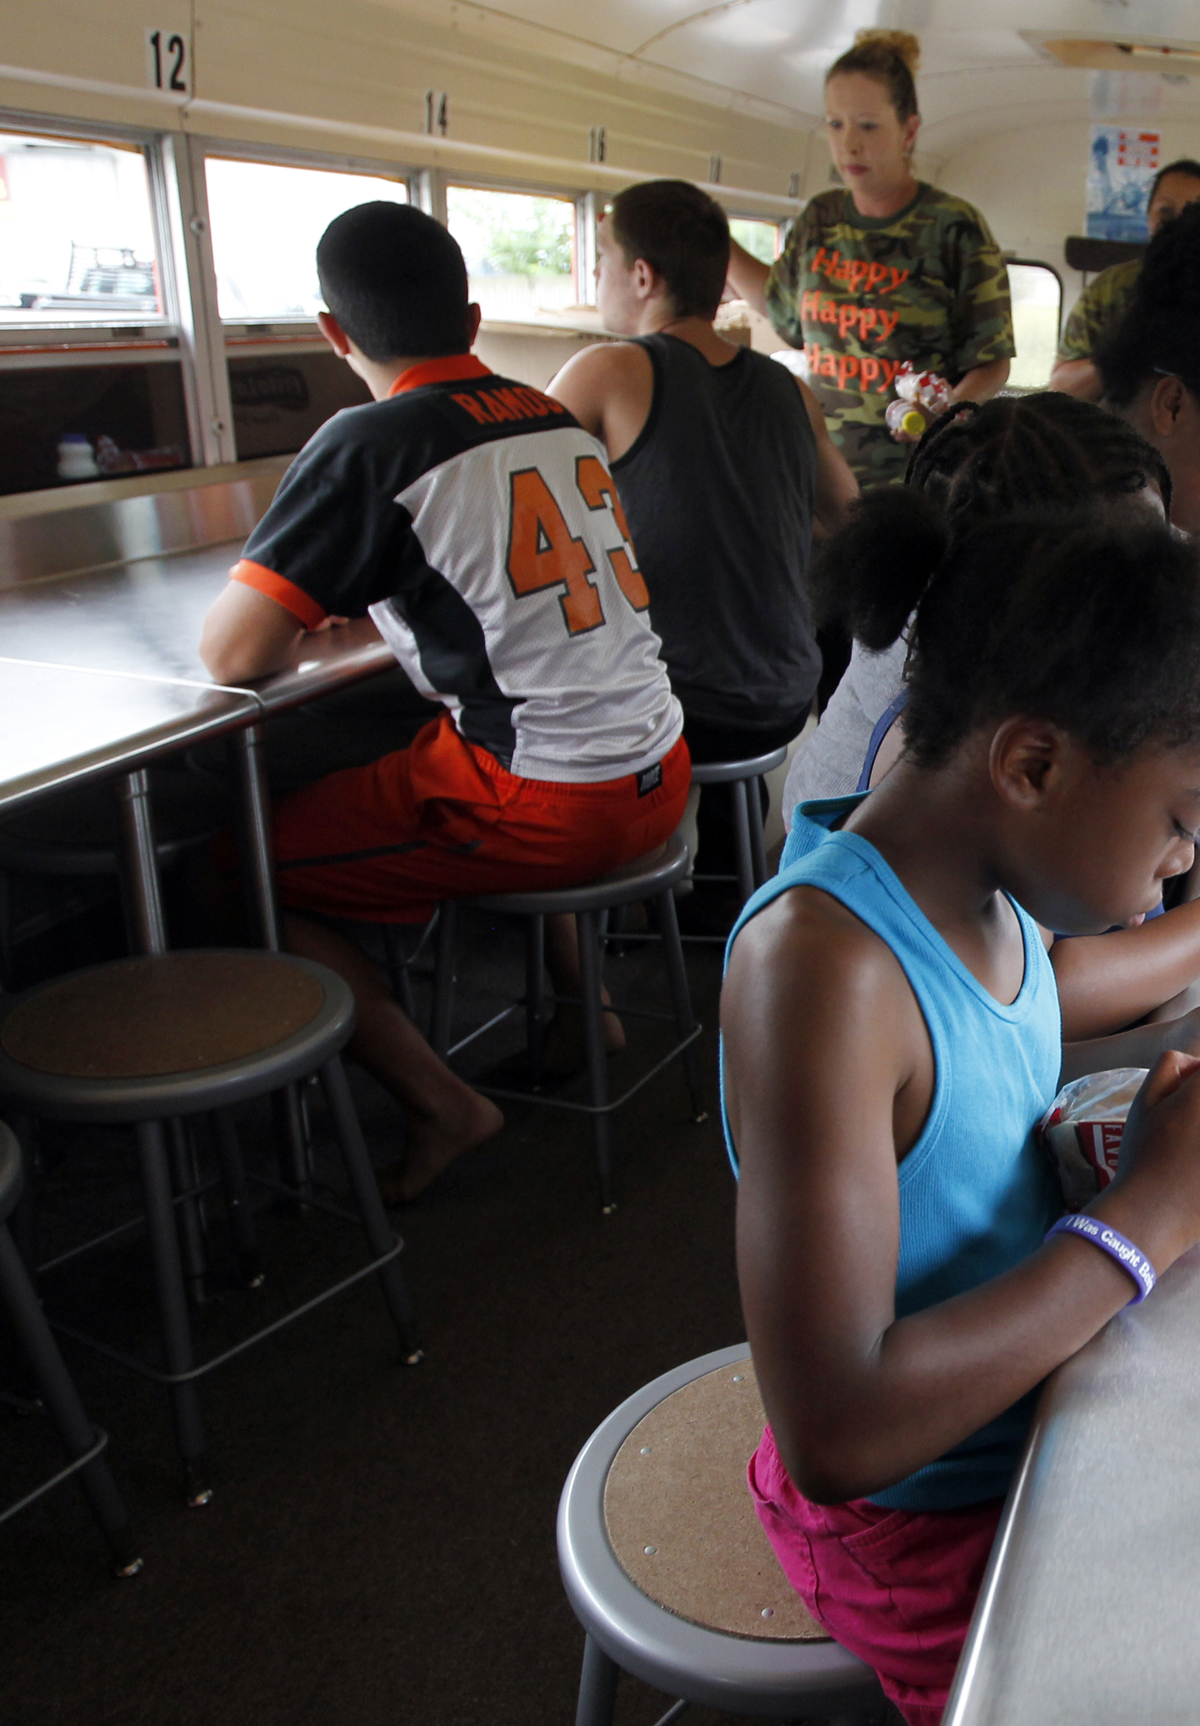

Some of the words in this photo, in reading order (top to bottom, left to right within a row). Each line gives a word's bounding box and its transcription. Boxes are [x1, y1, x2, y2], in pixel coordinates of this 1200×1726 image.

[150, 30, 187, 92] 12
[426, 88, 447, 136] 14
[811, 247, 910, 294] Happy
[801, 290, 900, 342] Happy
[803, 341, 900, 393] Happy
[450, 386, 565, 425] RAMOS
[505, 454, 651, 638] 43
[1065, 1216, 1075, 1227] I
[1072, 1216, 1099, 1236] Was
[1101, 1230, 1141, 1268] Caught
